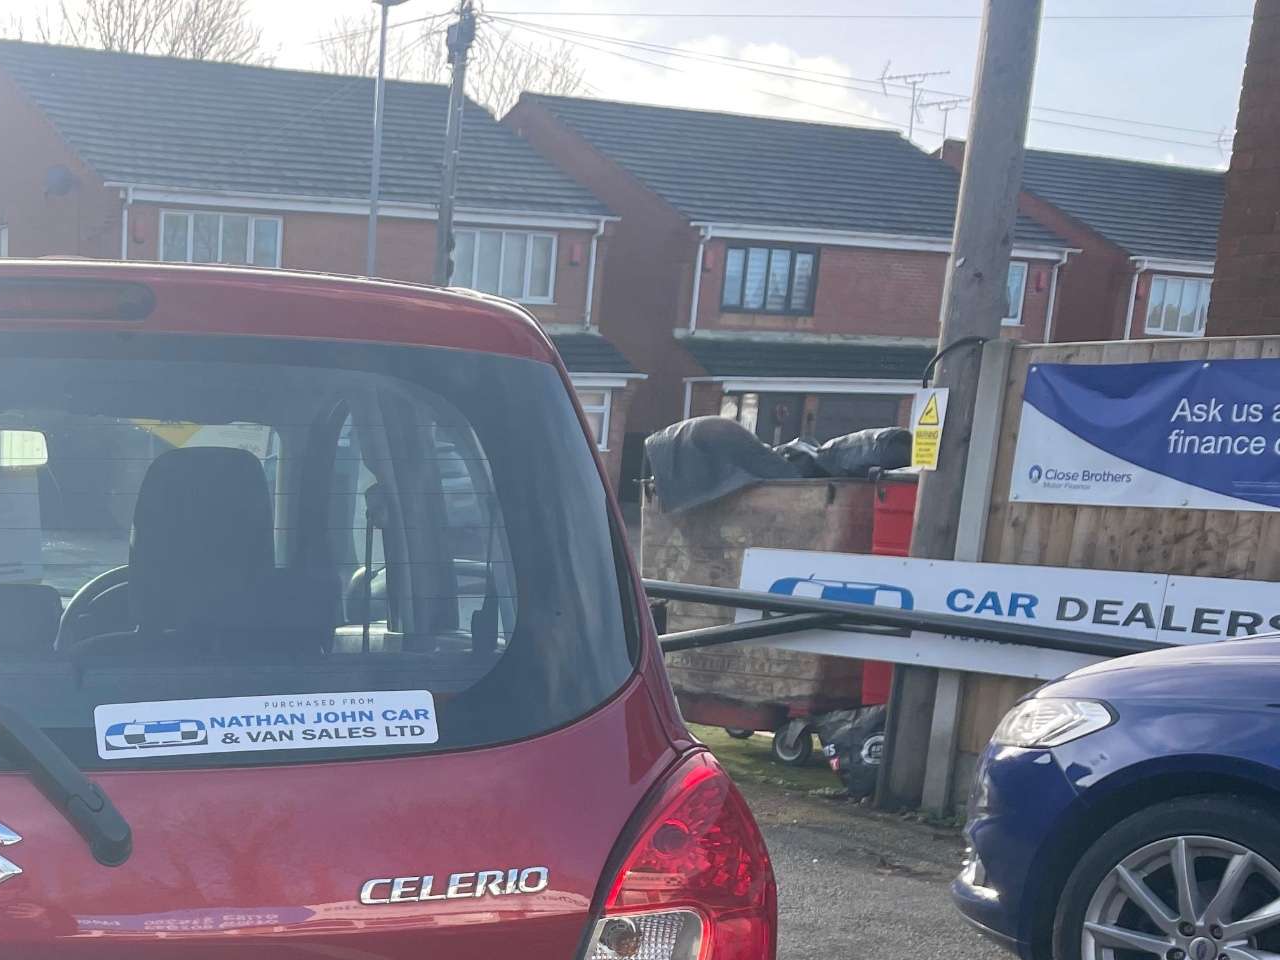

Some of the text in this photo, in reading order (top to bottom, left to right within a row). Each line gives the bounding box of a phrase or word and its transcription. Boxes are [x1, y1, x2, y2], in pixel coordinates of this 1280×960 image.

[1170, 398, 1224, 422] Ask
[1232, 403, 1264, 422] us
[1168, 429, 1266, 455] finance
[1045, 468, 1133, 483] Close Brothers
[945, 588, 1040, 619] CAR
[264, 700, 335, 709] PURCHASED
[209, 708, 430, 729] NATHAN JOHN CAR
[221, 725, 425, 745] & VAN SALES LTD
[360, 866, 550, 905] CELERIO
